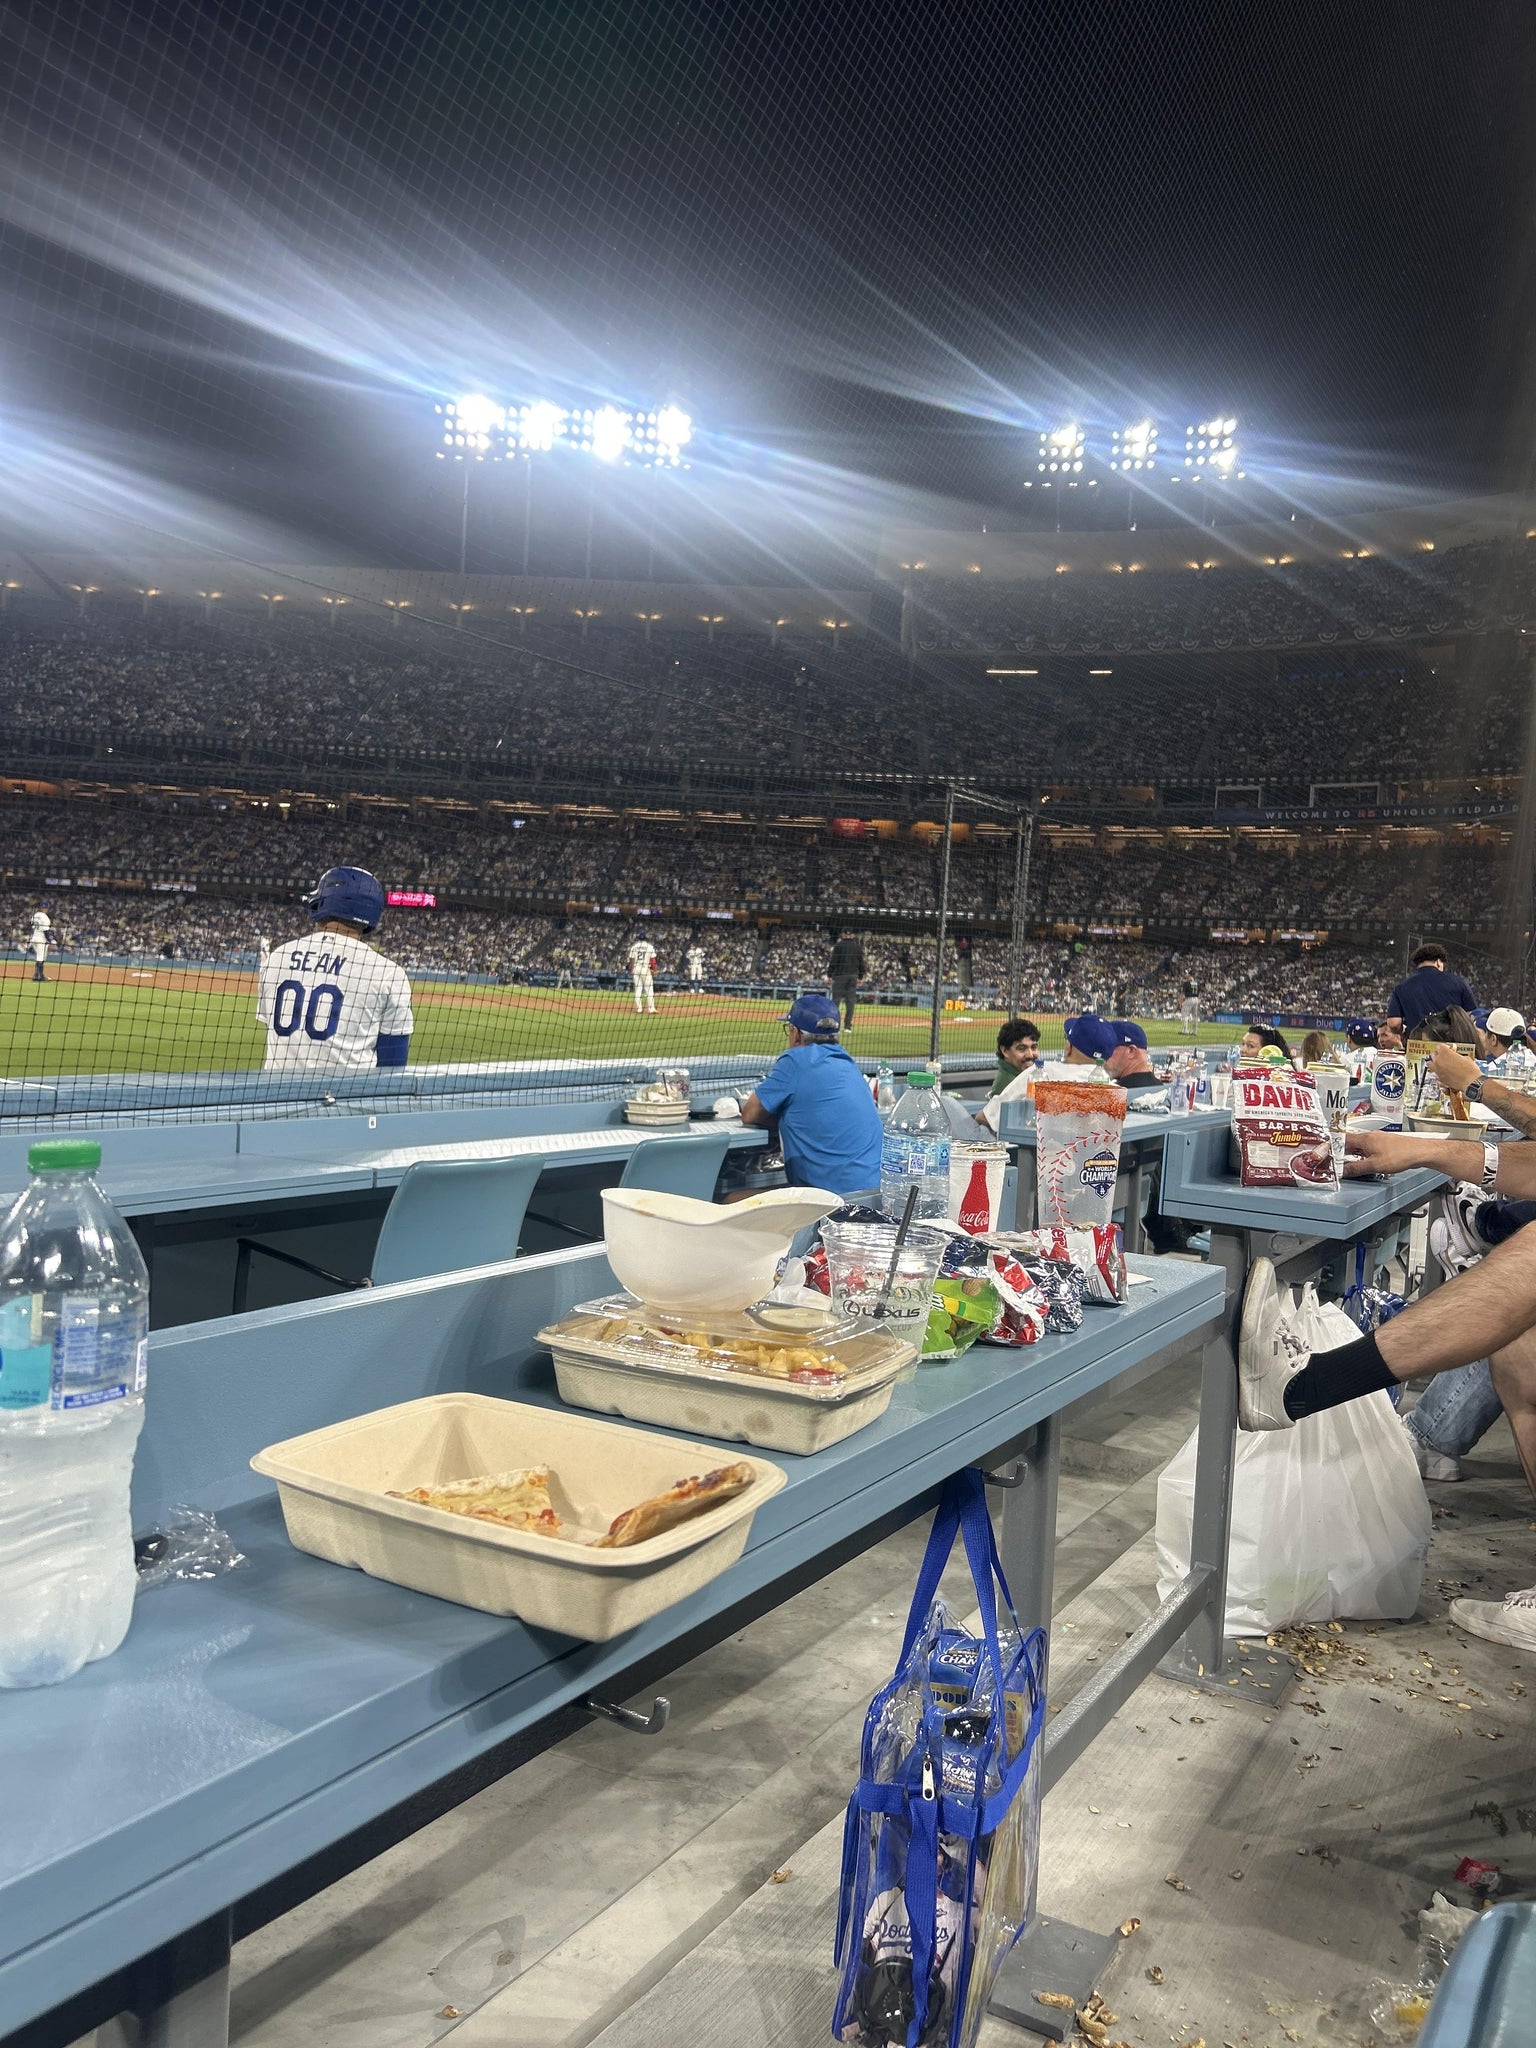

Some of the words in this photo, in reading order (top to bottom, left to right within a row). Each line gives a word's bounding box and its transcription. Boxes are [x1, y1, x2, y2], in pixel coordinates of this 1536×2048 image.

[1265, 810, 1328, 820] WELCOME
[1335, 810, 1351, 818] TO
[1443, 806, 1481, 815] FIELD
[1488, 804, 1504, 814] AT
[289, 950, 347, 976] SEAN
[273, 979, 345, 1040] 00
[1252, 1015, 1272, 1025] blue
[1316, 1019, 1334, 1028] blue
[1270, 1131, 1302, 1144] Jumbo
[862, 1306, 921, 1319] LEXUS
